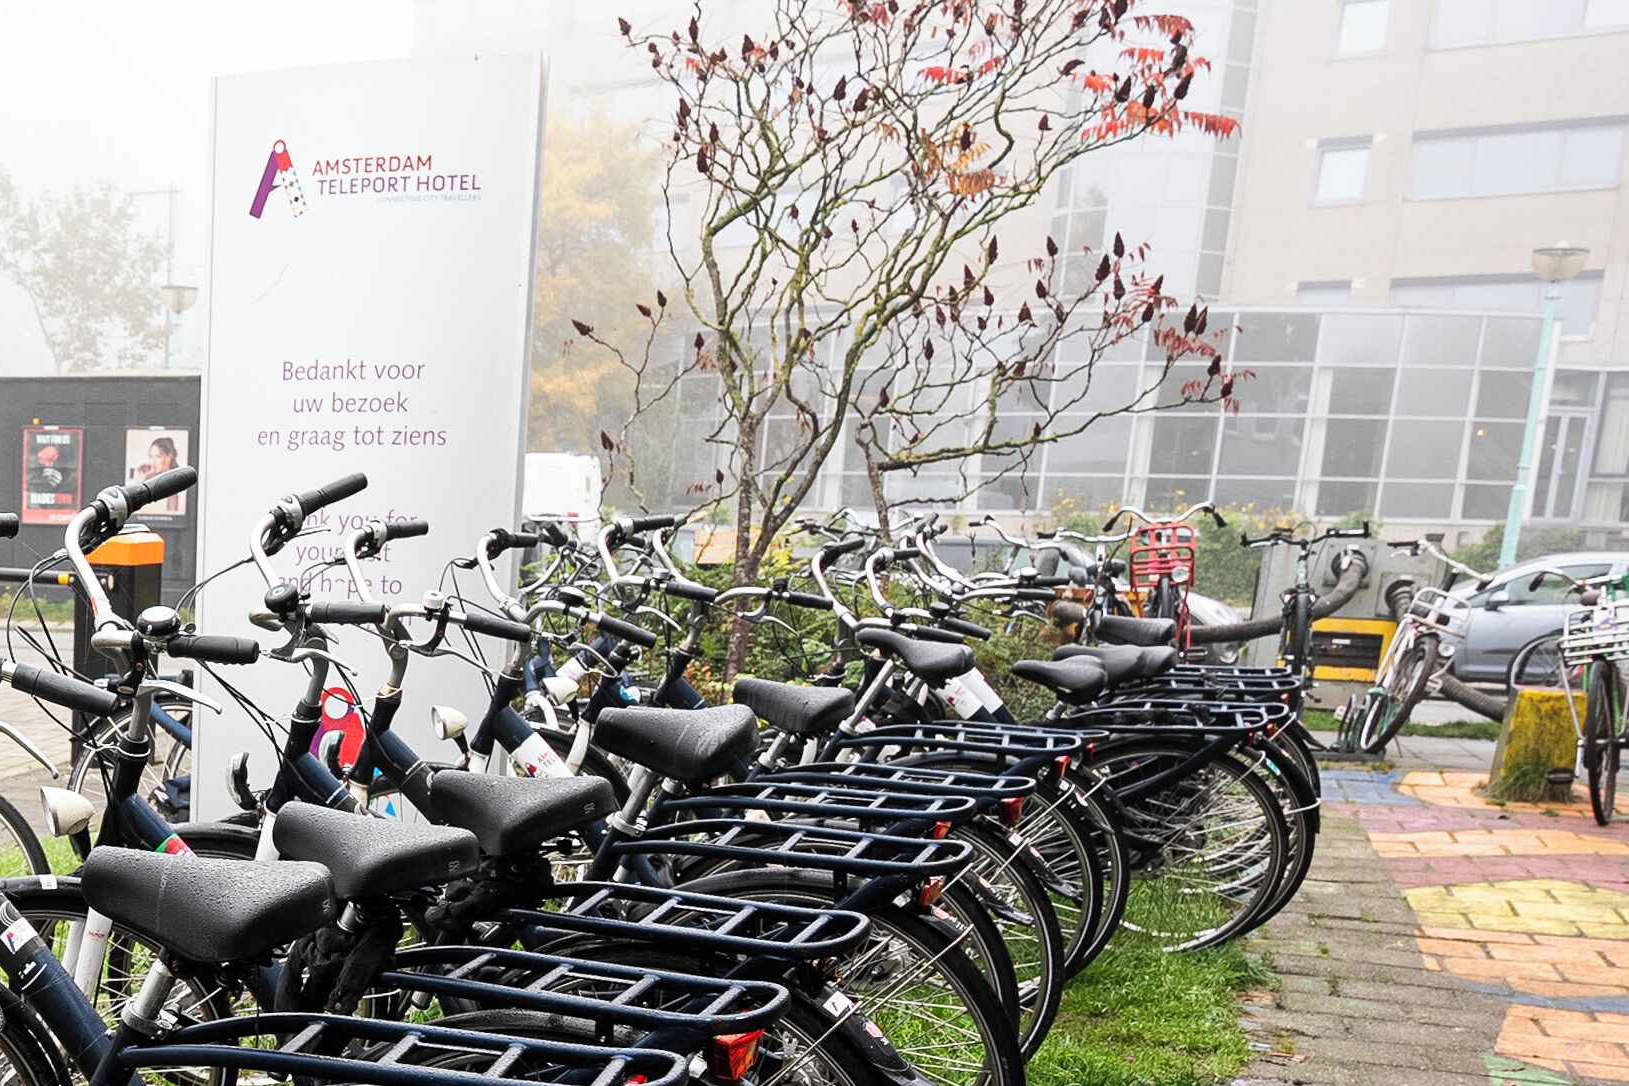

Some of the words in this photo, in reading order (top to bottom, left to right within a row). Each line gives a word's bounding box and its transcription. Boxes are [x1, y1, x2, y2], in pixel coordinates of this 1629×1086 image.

[312, 154, 432, 176] AMSTERDAM
[318, 176, 411, 195] TELEPORT
[417, 174, 481, 192] HOTEL
[423, 194, 438, 202] CITY
[282, 358, 367, 381] Bedankt
[373, 363, 426, 380] voor
[293, 397, 324, 413] uw
[331, 391, 409, 413] bezoek
[257, 430, 280, 446] en
[287, 430, 346, 452] graag
[353, 425, 385, 446] tot
[391, 425, 447, 446] ziens
[338, 514, 377, 536] yo
[381, 575, 402, 595] to
